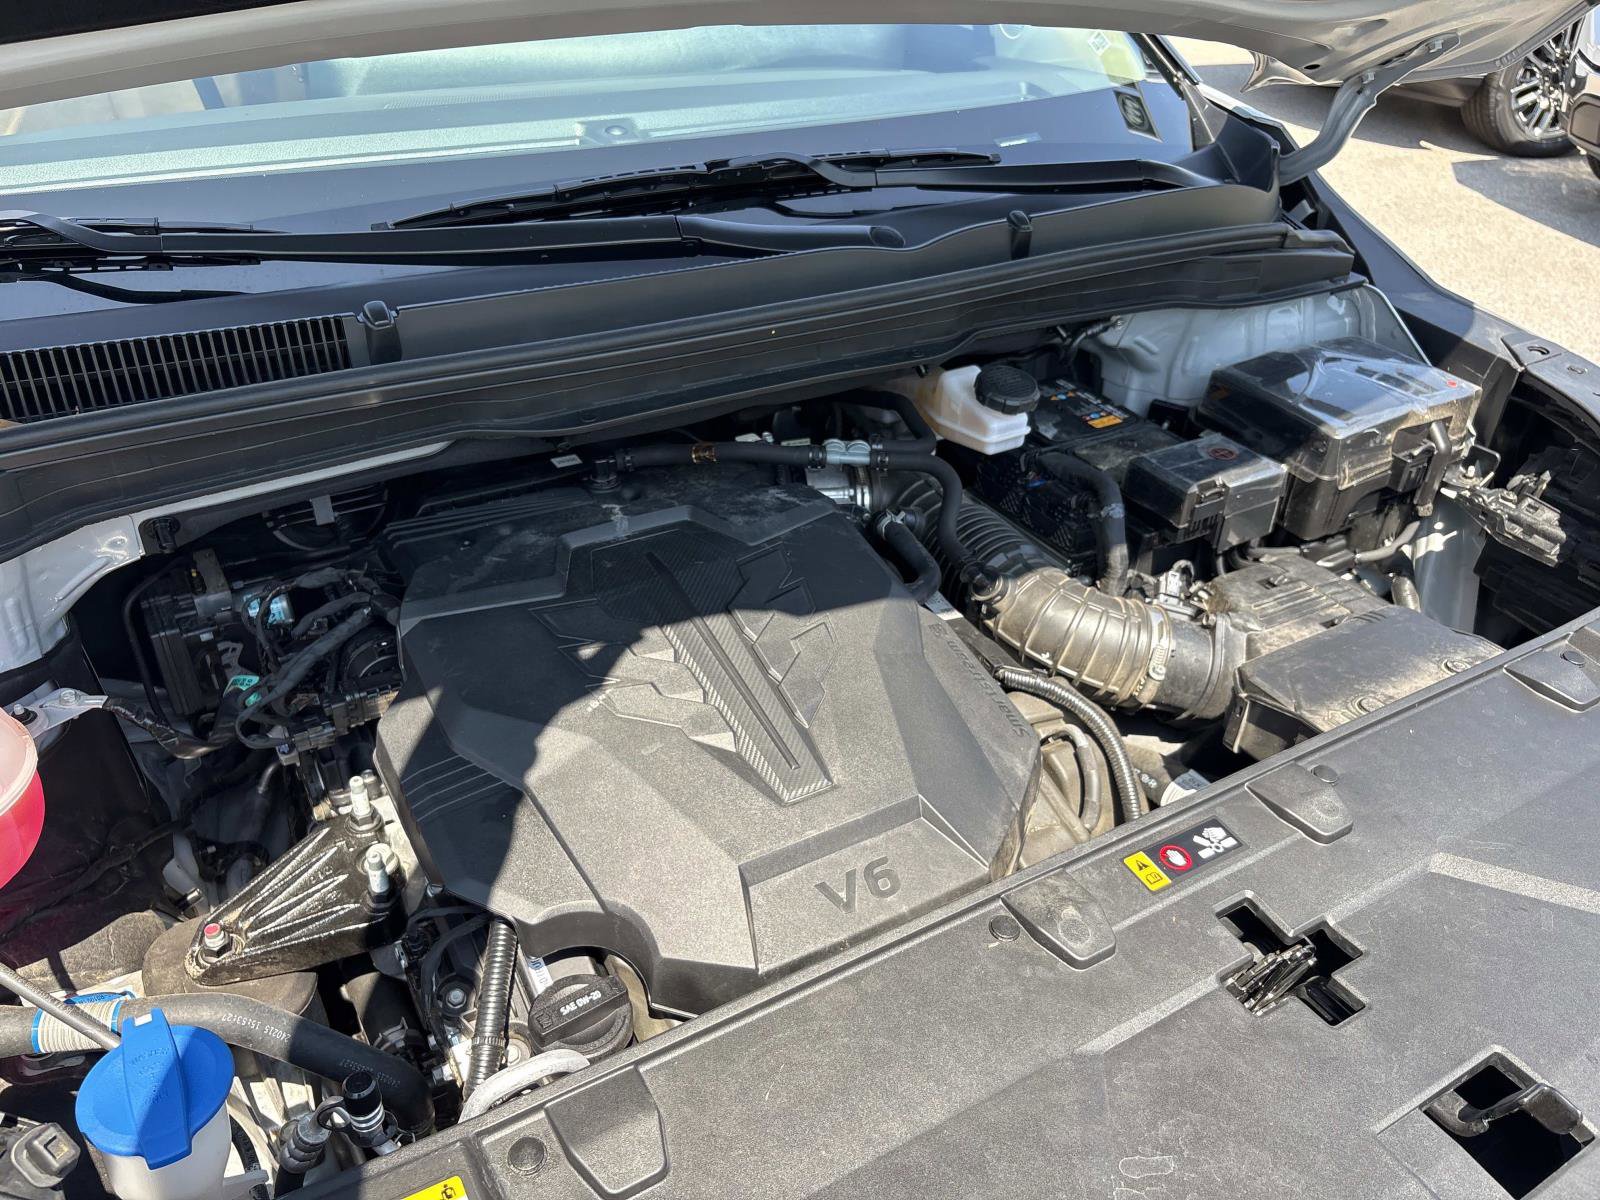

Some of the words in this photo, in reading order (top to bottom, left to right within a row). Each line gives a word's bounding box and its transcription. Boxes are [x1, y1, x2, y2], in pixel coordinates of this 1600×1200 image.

[814, 856, 901, 914] V6
[559, 1001, 578, 1016] SAE
[575, 990, 602, 1008] 0W-20
[221, 1012, 261, 1030] 15:53:27
[263, 1024, 292, 1043] 240215
